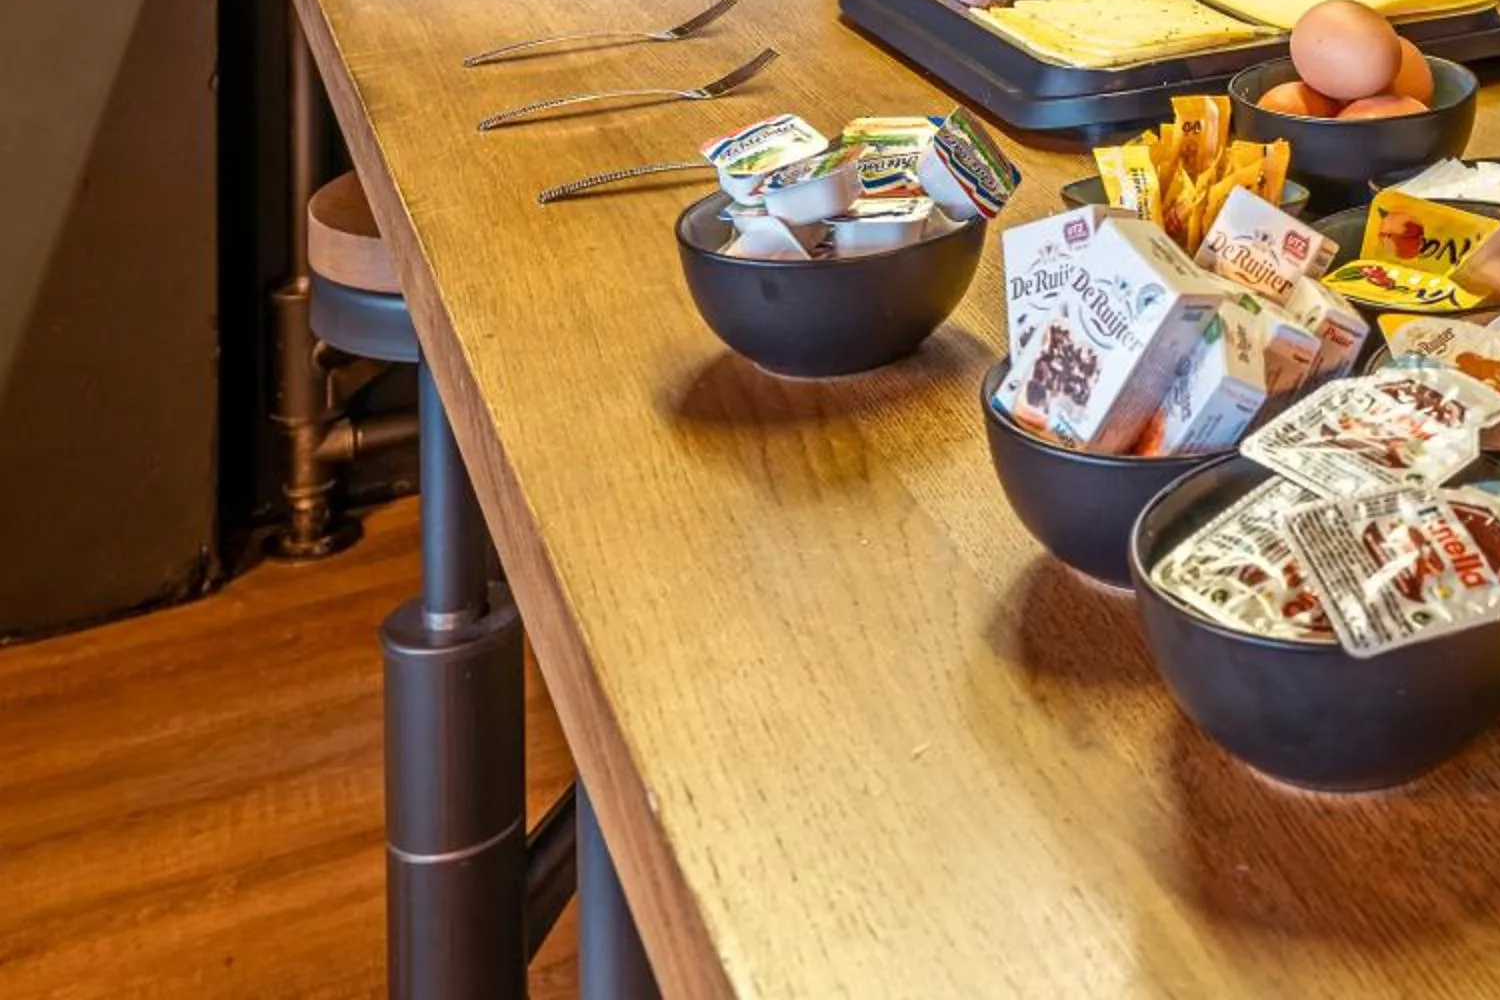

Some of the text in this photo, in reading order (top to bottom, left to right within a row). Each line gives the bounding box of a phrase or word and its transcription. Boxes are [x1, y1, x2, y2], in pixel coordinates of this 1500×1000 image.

[1010, 263, 1075, 300] De Ruij
[1206, 230, 1234, 261] De
[1233, 245, 1293, 294] Ruijter
[1072, 267, 1144, 352] De Ruijter
